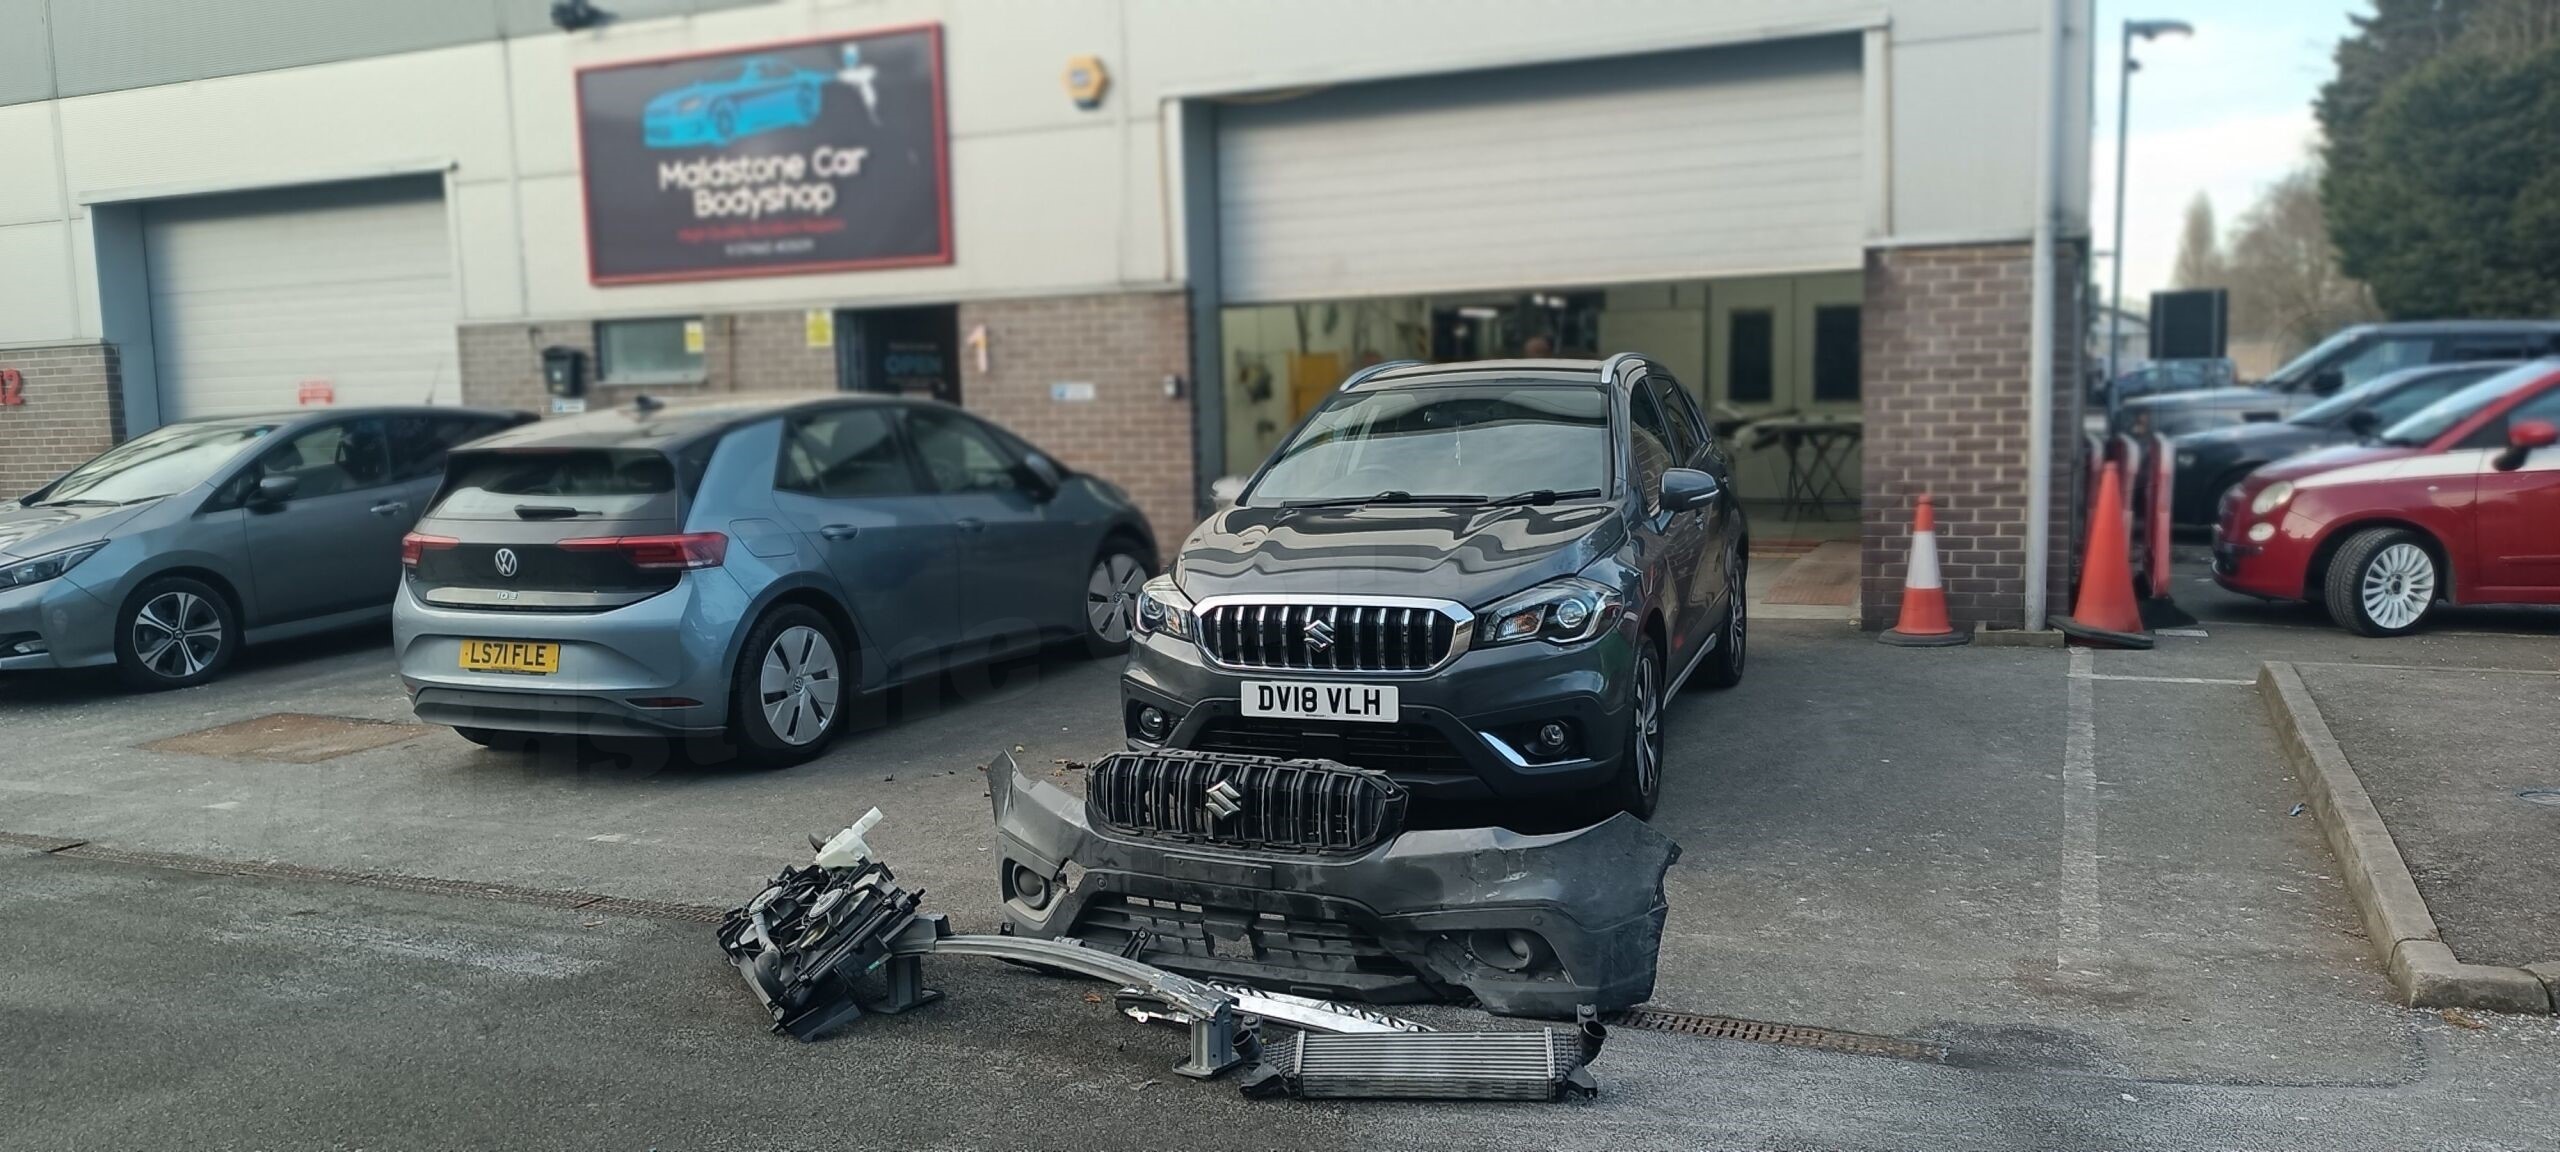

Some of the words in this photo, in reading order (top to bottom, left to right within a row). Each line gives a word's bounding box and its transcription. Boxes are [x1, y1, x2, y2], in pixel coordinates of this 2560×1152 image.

[812, 146, 868, 177] Car
[693, 183, 836, 218] Bodyshop
[470, 642, 508, 665] LS71
[512, 644, 547, 667] FLE
[1258, 685, 1318, 713] DV18
[1327, 687, 1381, 716] VLH
